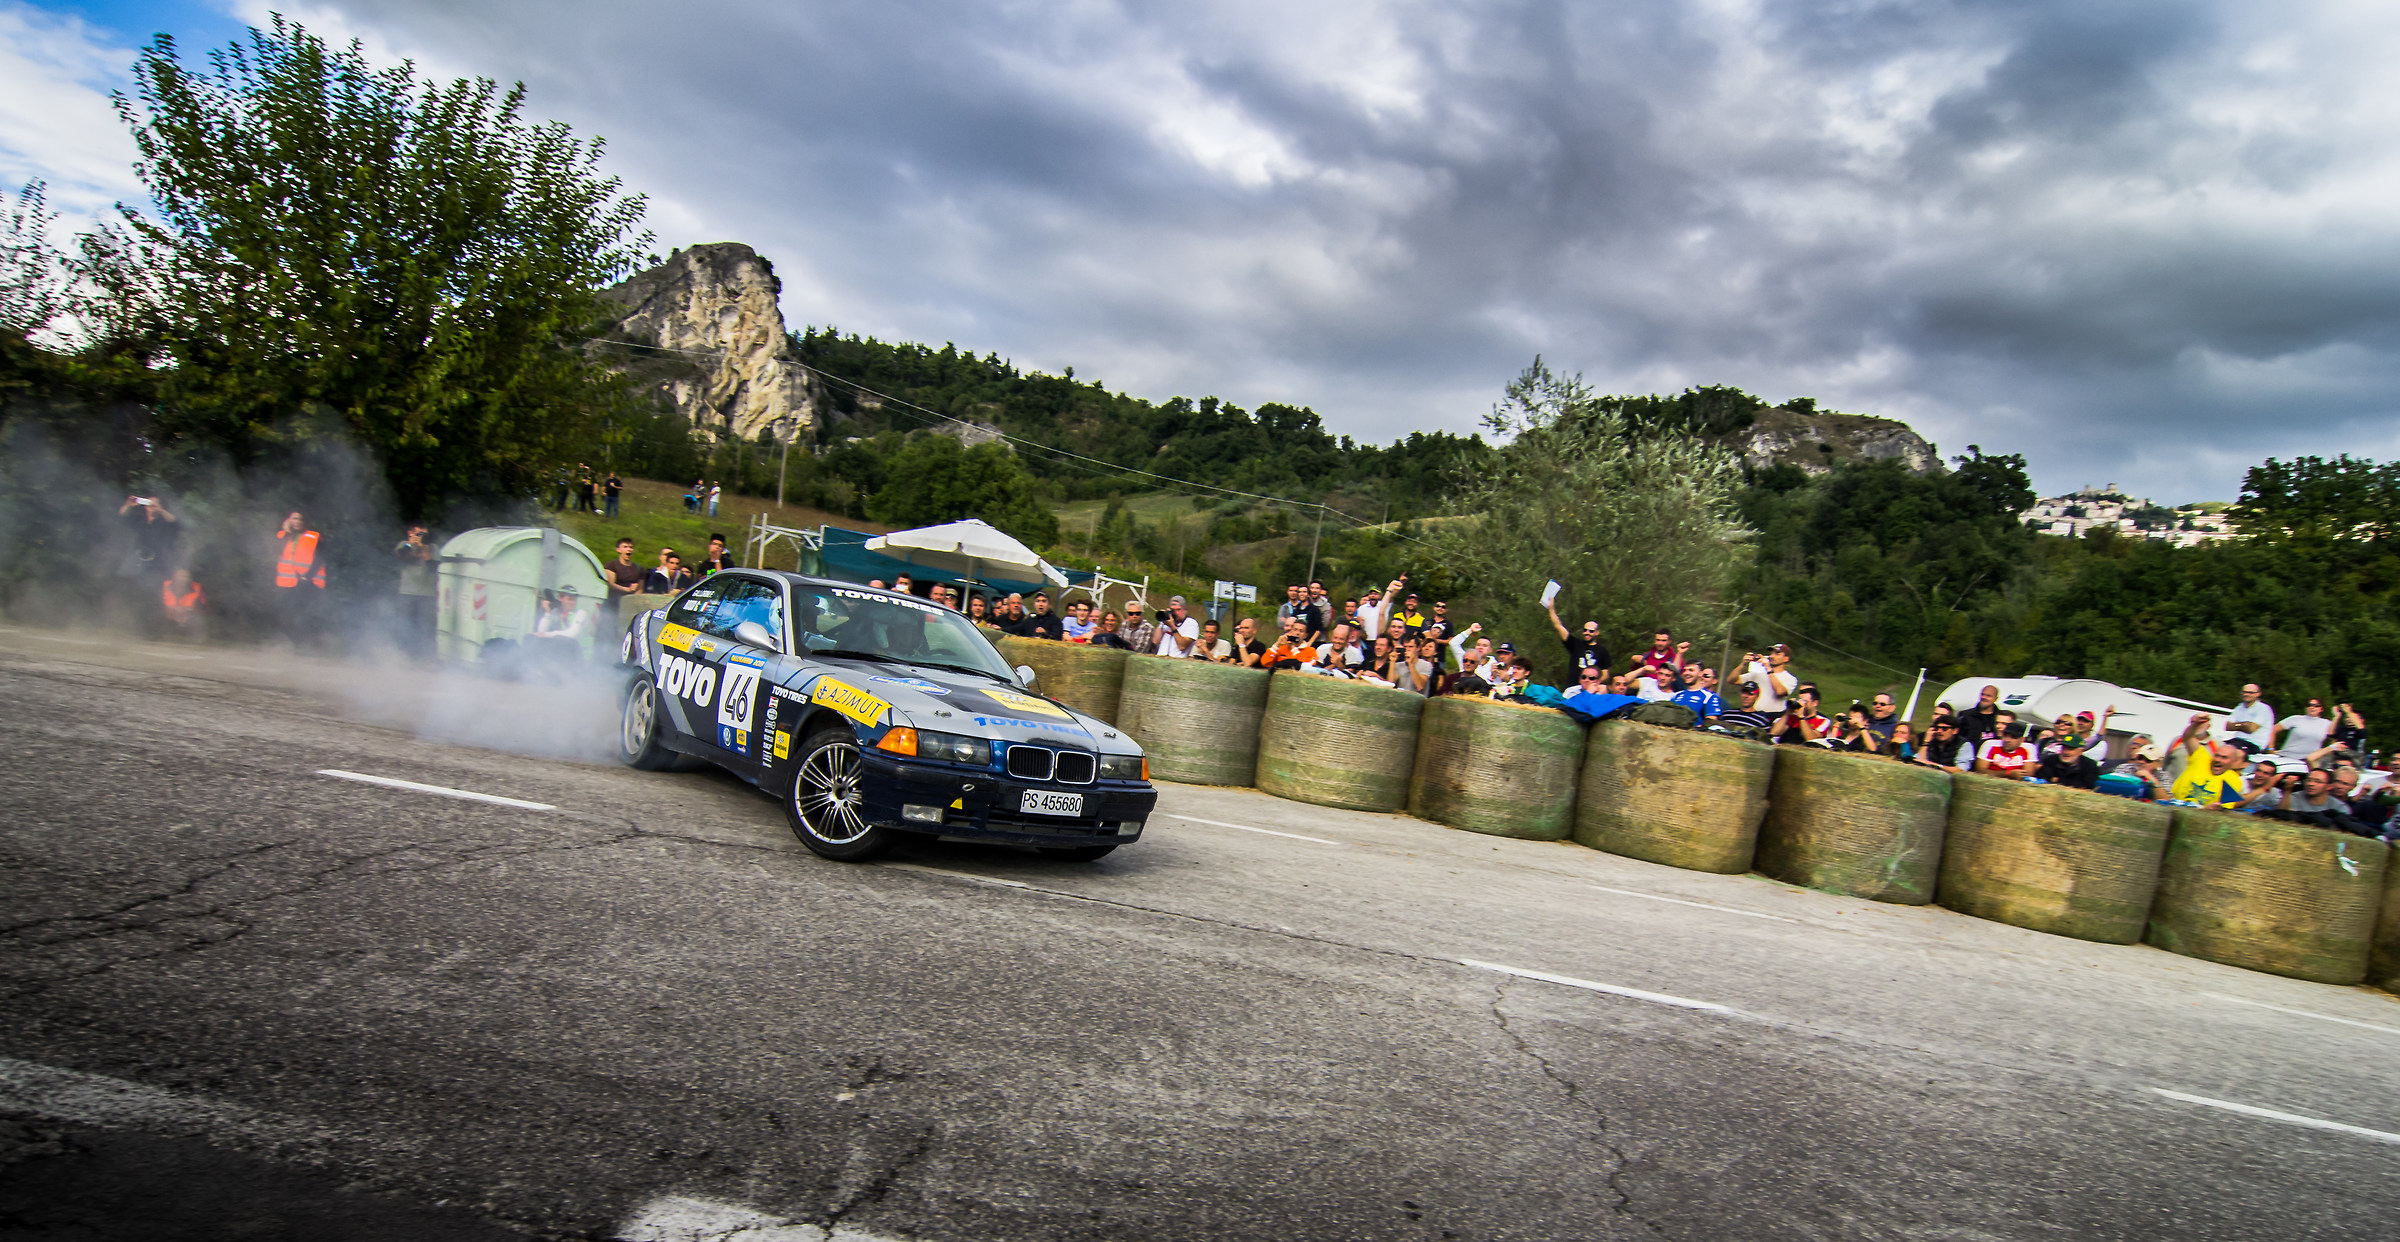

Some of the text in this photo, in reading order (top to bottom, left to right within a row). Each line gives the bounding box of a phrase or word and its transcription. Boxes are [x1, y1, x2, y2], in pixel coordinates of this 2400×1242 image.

[831, 588, 944, 616] TOYO TIRES
[668, 628, 696, 647] AZIMUT
[656, 653, 716, 707] TOYO
[725, 674, 753, 722] 46
[771, 685, 808, 705] TOYO TIRES
[826, 687, 883, 718] AZIMUT
[974, 717, 1037, 728] TOYO
[1022, 792, 1081, 812] PS 455680
